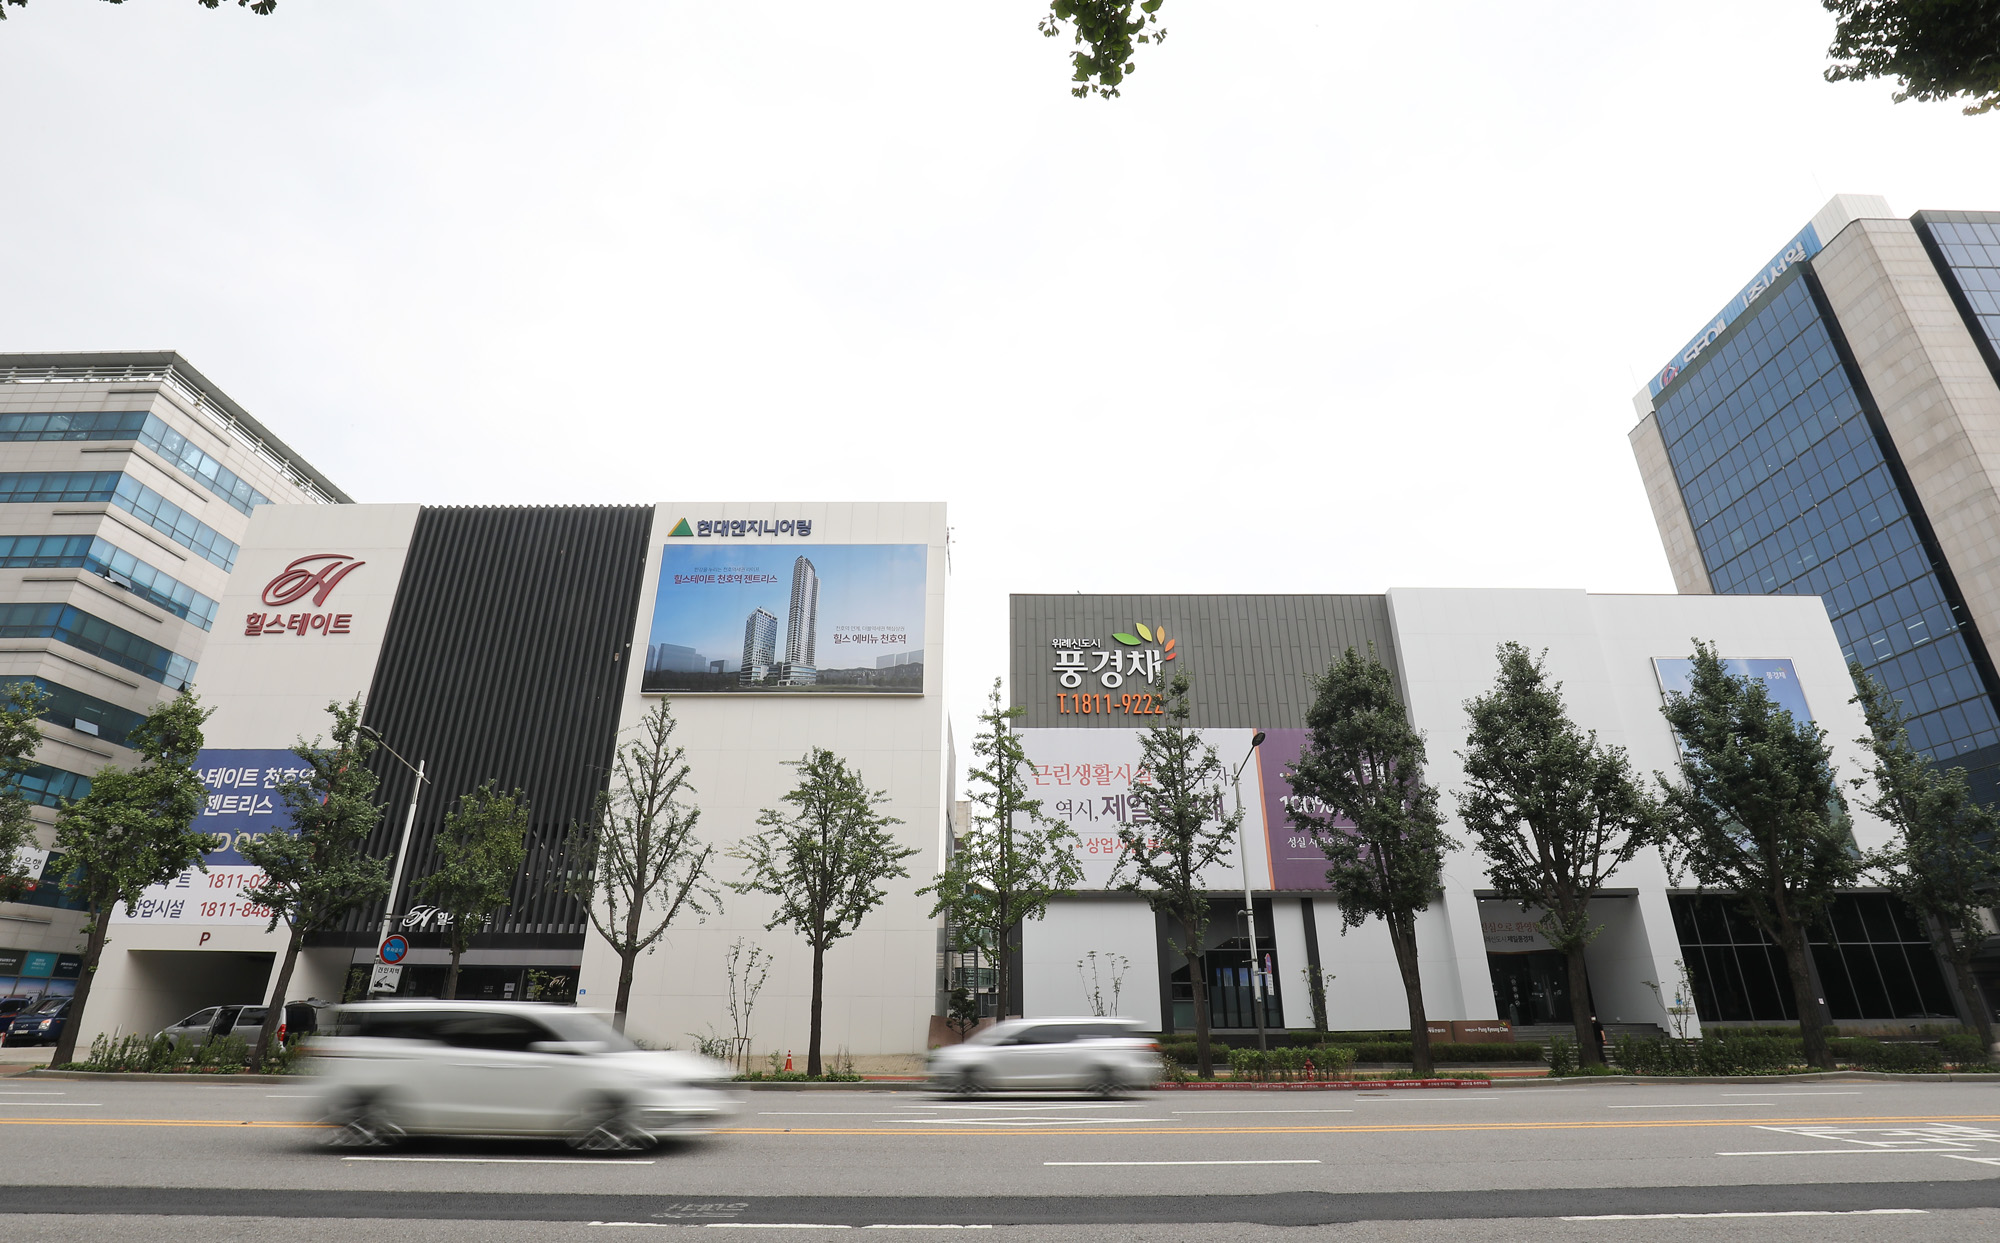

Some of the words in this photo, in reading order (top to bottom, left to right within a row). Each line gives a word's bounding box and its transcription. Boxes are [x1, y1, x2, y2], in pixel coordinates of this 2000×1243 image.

[697, 519, 812, 537] 현대엔지니어링
[674, 574, 715, 584] 힐스테이트
[717, 574, 742, 584] 천호역
[744, 574, 778, 584] 젠트리스
[244, 612, 352, 636] 힐스테이트
[833, 633, 851, 645] 힐스
[852, 633, 879, 645] 에비뉴
[880, 633, 907, 645] 천호역
[1051, 638, 1101, 650] 위례신도시
[1052, 649, 1163, 689] 풍경채
[188, 767, 259, 789] 스테이트
[1031, 763, 1152, 786] 근린생활시설
[203, 794, 273, 816] 젠트리스
[1055, 798, 1099, 822] 역시,
[1287, 837, 1306, 848] 성실
[199, 932, 211, 946] P
